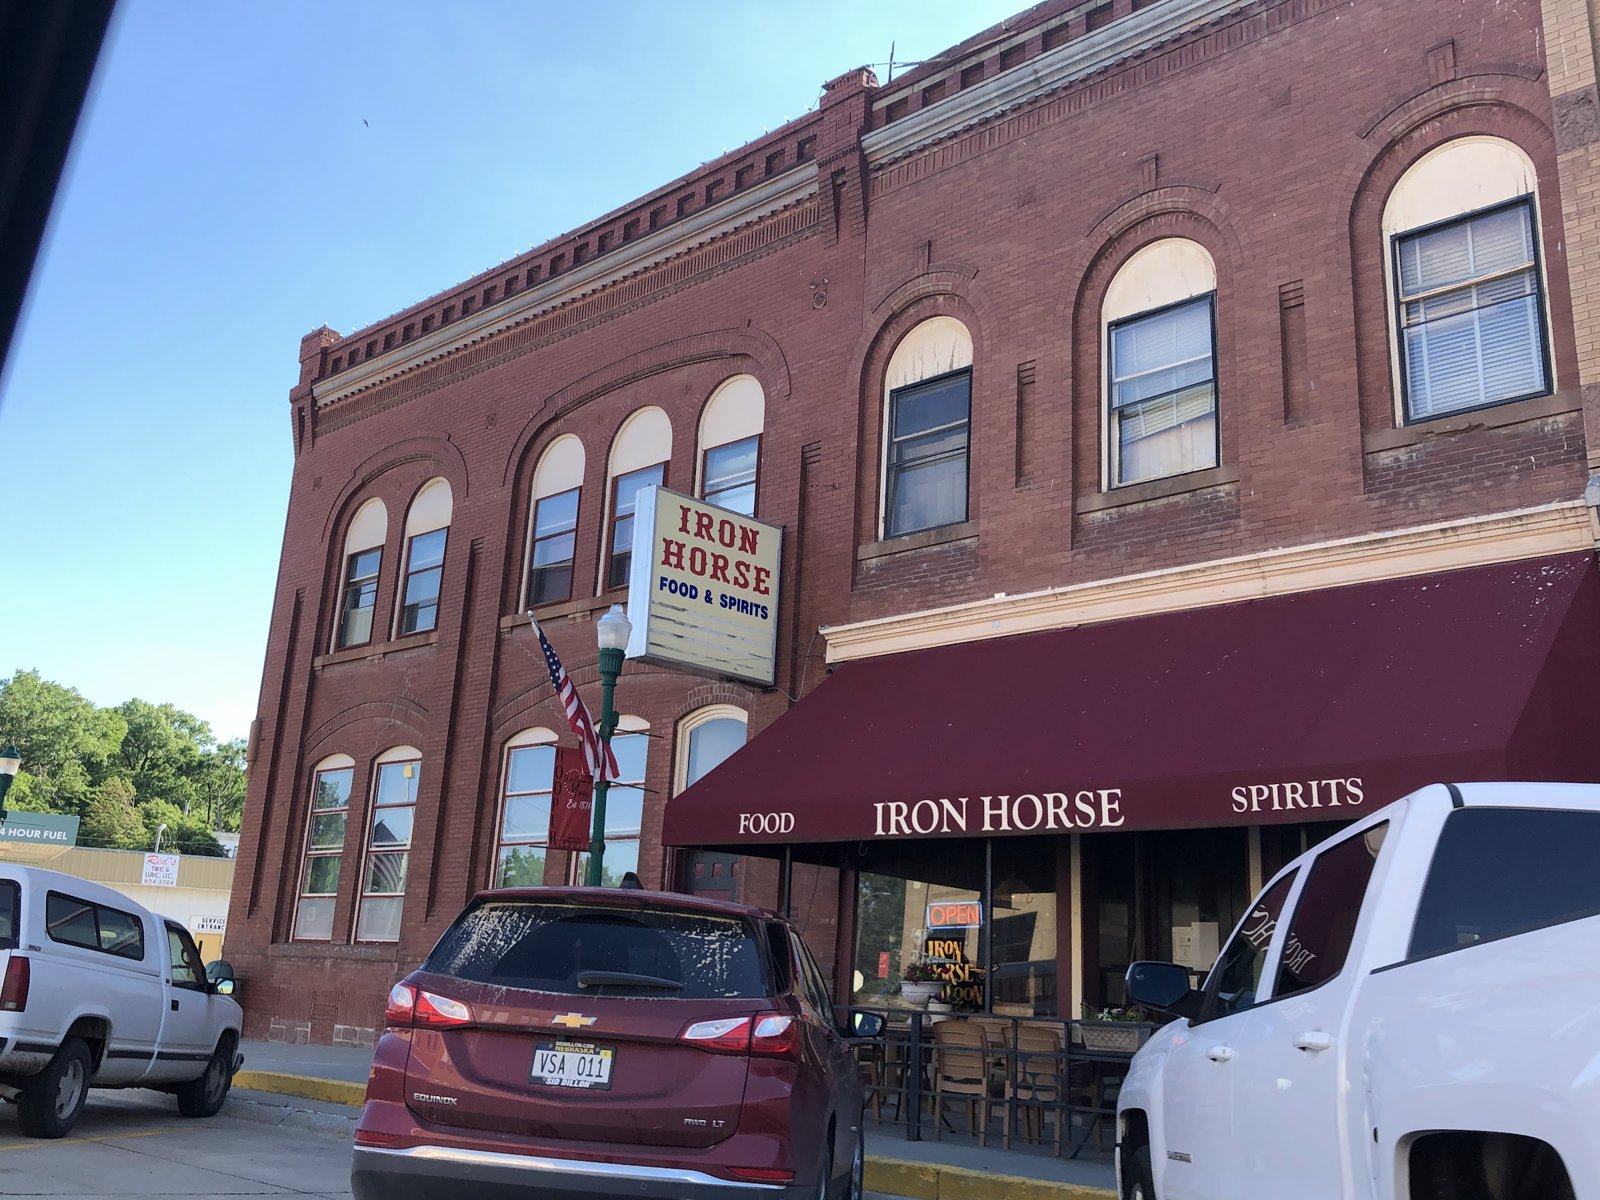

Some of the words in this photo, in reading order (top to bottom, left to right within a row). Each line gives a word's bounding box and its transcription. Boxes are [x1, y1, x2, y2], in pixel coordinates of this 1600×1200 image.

[679, 505, 759, 555] IRON
[661, 537, 770, 595] HORSE
[659, 576, 698, 600] FOOD
[704, 590, 713, 605] &
[719, 593, 768, 620] SPIRITS
[738, 812, 795, 834] FOOD
[874, 799, 968, 836] IRON
[981, 788, 1125, 831] HORSE
[1231, 777, 1364, 813] SPIRITS
[8, 828, 41, 839] HOUR
[43, 831, 68, 841] FUEL
[147, 855, 177, 866] Red's
[202, 917, 226, 925] SERVICE
[930, 905, 980, 926] OPEN
[197, 923, 225, 931] ENTRANC
[927, 940, 963, 963] IRON
[931, 962, 974, 986] RSE
[540, 1052, 566, 1075] VSA
[577, 1056, 603, 1078] 011
[545, 1077, 560, 1086] SID
[561, 1079, 590, 1088] DILLON
[413, 1092, 458, 1105] EQUINOX
[712, 1120, 726, 1128] LT
